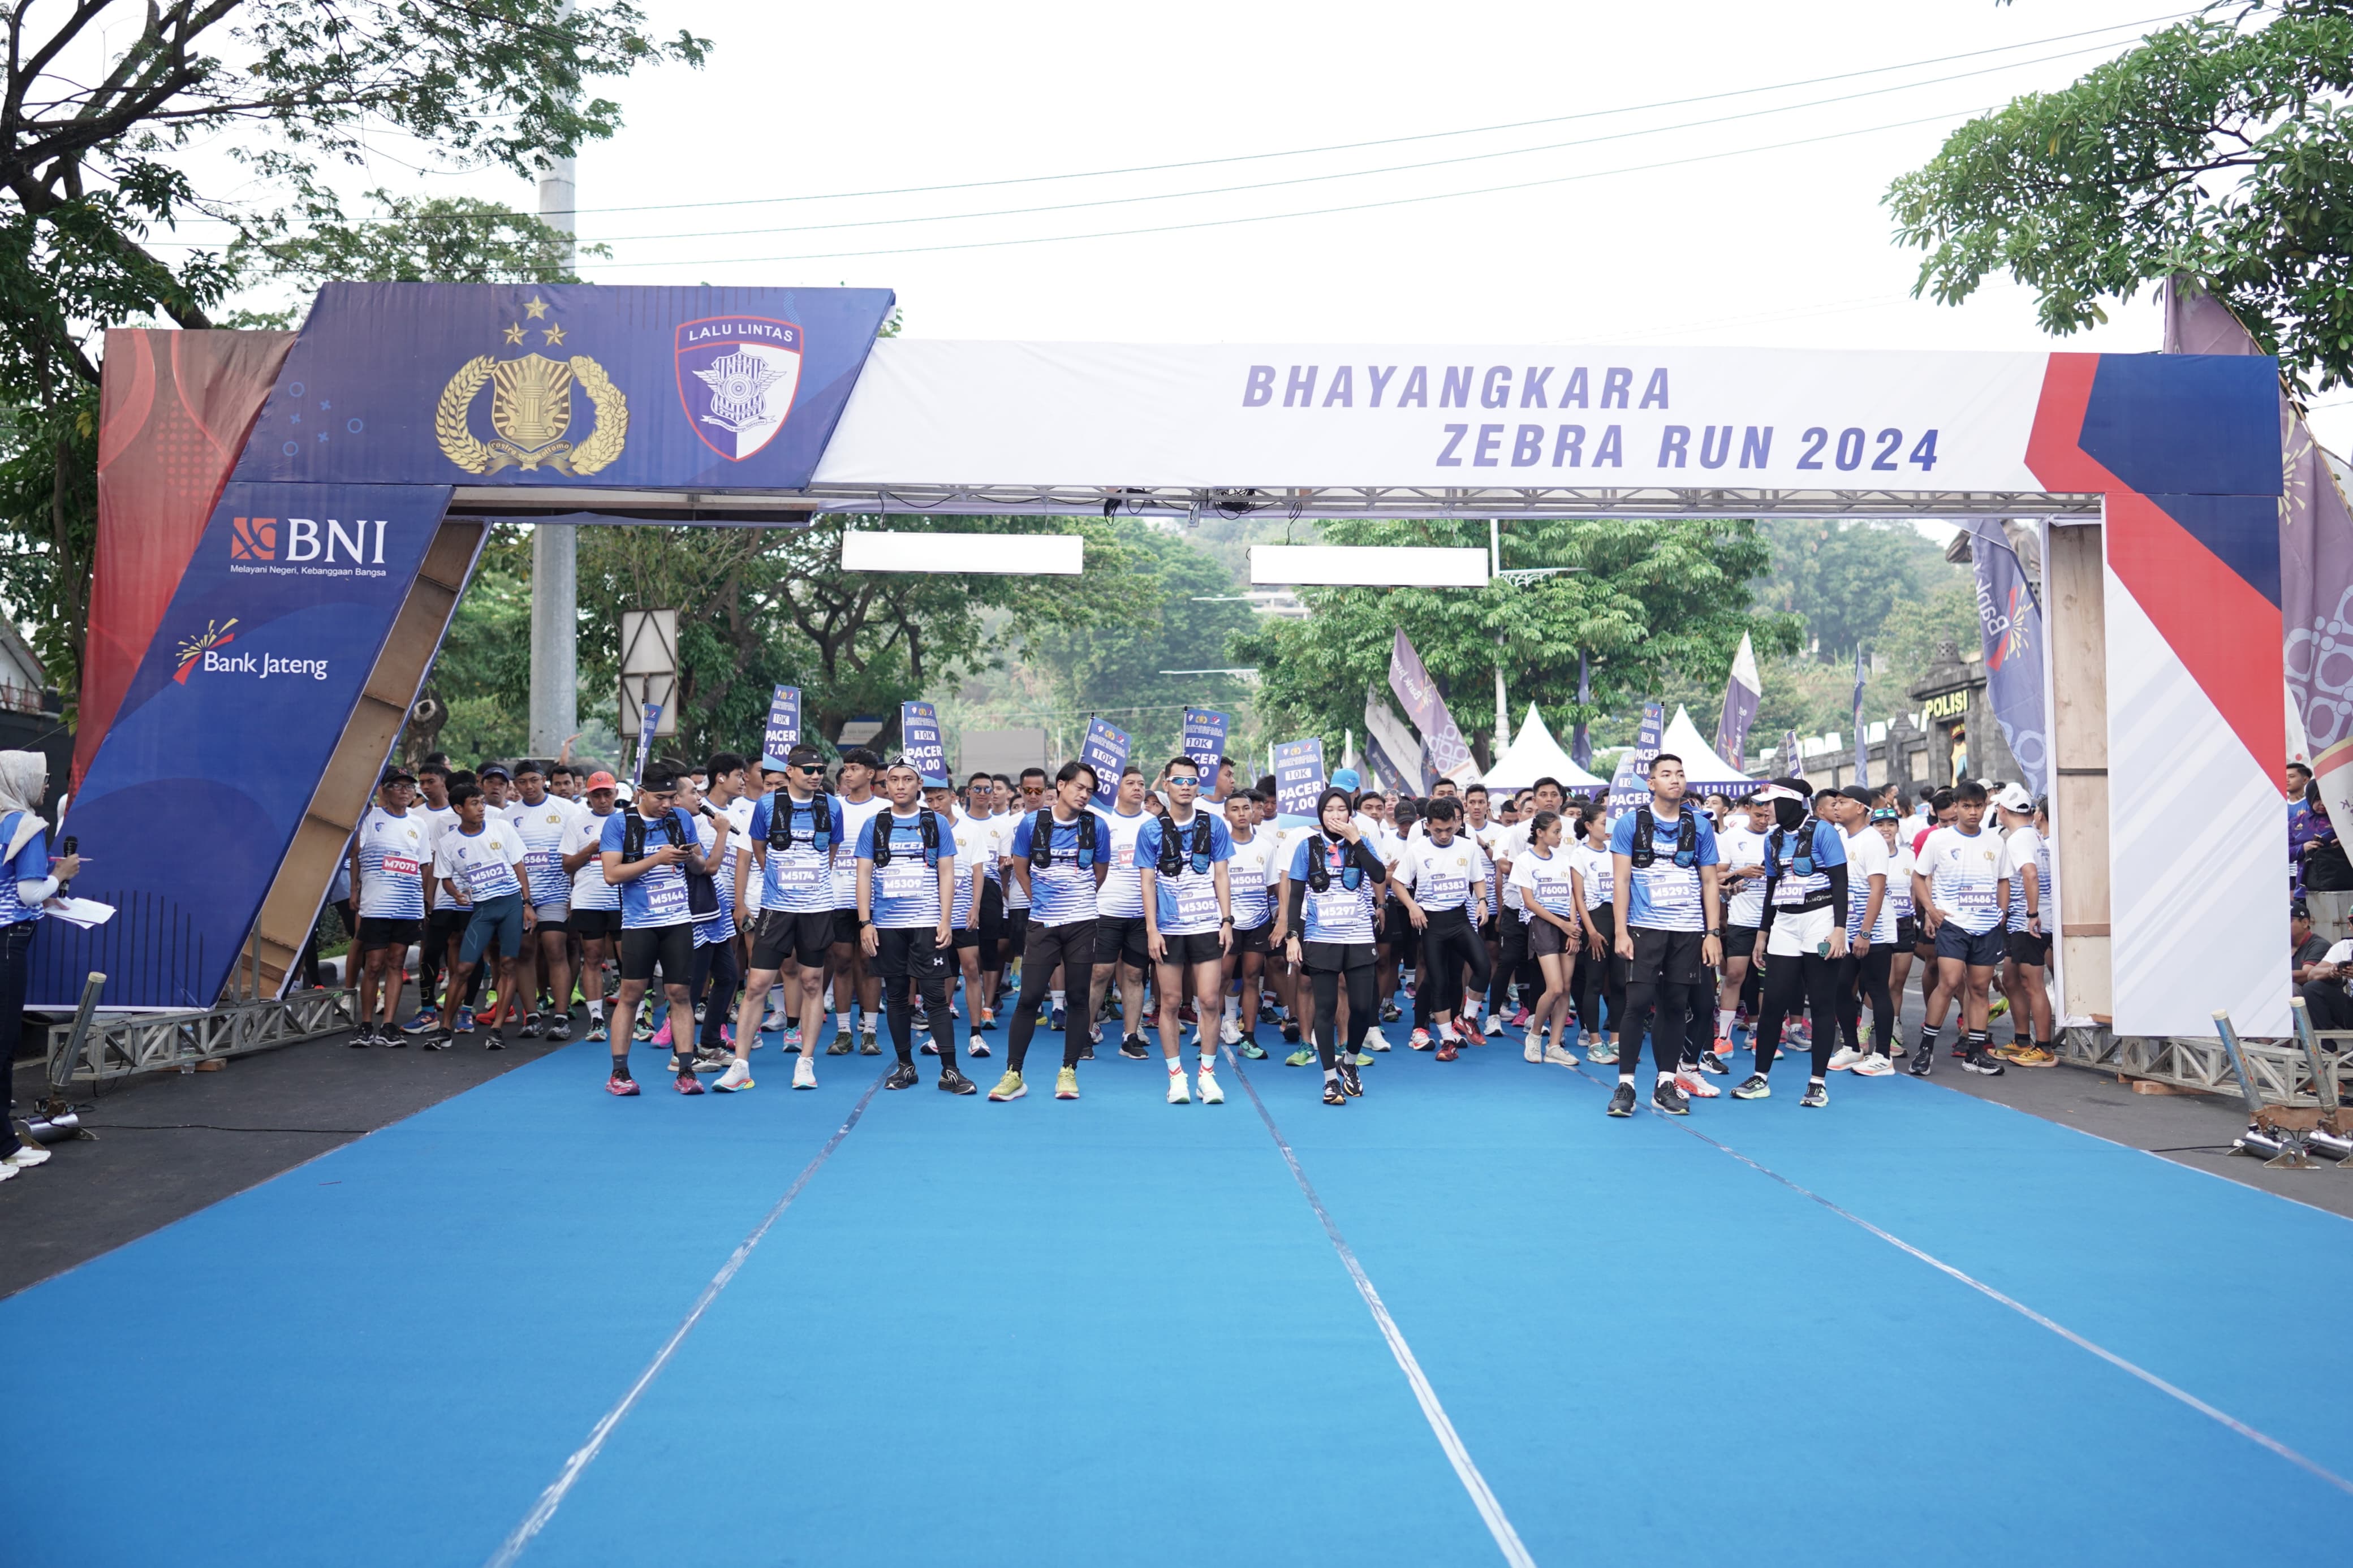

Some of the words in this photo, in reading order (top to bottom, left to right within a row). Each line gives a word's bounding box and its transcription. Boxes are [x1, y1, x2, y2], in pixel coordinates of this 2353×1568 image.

[689, 324, 732, 342] LALU
[738, 323, 793, 342] LINTAS
[1242, 365, 1669, 409] BHAYANGKARA
[1436, 424, 1622, 467] ZEBRA
[1657, 425, 1774, 469] RUN
[1796, 427, 1939, 471] 2024
[285, 518, 389, 565] BNI
[230, 564, 267, 574] Melayani
[269, 566, 299, 576] Negeri,
[301, 567, 353, 576] Kebanggaan
[355, 568, 386, 577] Bangsa
[204, 650, 257, 672] Bank
[260, 653, 329, 680] Jateng
[1925, 689, 1968, 720] POLISI
[774, 714, 787, 724] 10K
[765, 729, 796, 742] PACER
[917, 731, 933, 740] 10K
[1642, 732, 1653, 743] 10K
[769, 743, 791, 755] 7.00
[1188, 738, 1209, 748] 10K
[906, 745, 942, 758] PACER
[1096, 750, 1114, 766] 10K
[1635, 748, 1660, 761] PACER
[1288, 769, 1308, 779] 10K
[1636, 763, 1650, 775] 8.0
[1622, 779, 1632, 787] 10
[1278, 780, 1322, 802] PACER
[1285, 796, 1317, 814] 7.00
[1609, 792, 1652, 806] PACER
[384, 859, 416, 872] M7075
[524, 854, 549, 864] 5564
[470, 866, 504, 882] M5102
[781, 871, 815, 881] M5174
[1230, 875, 1263, 885] M5065
[884, 879, 922, 889] M5309
[1433, 880, 1465, 892] M5383
[650, 891, 684, 905] M5144
[1651, 885, 1690, 899] M5293
[1774, 886, 1803, 897] M5301
[1959, 895, 1991, 904] M5486
[1179, 900, 1216, 914] M5305
[1318, 905, 1356, 917] M5297
